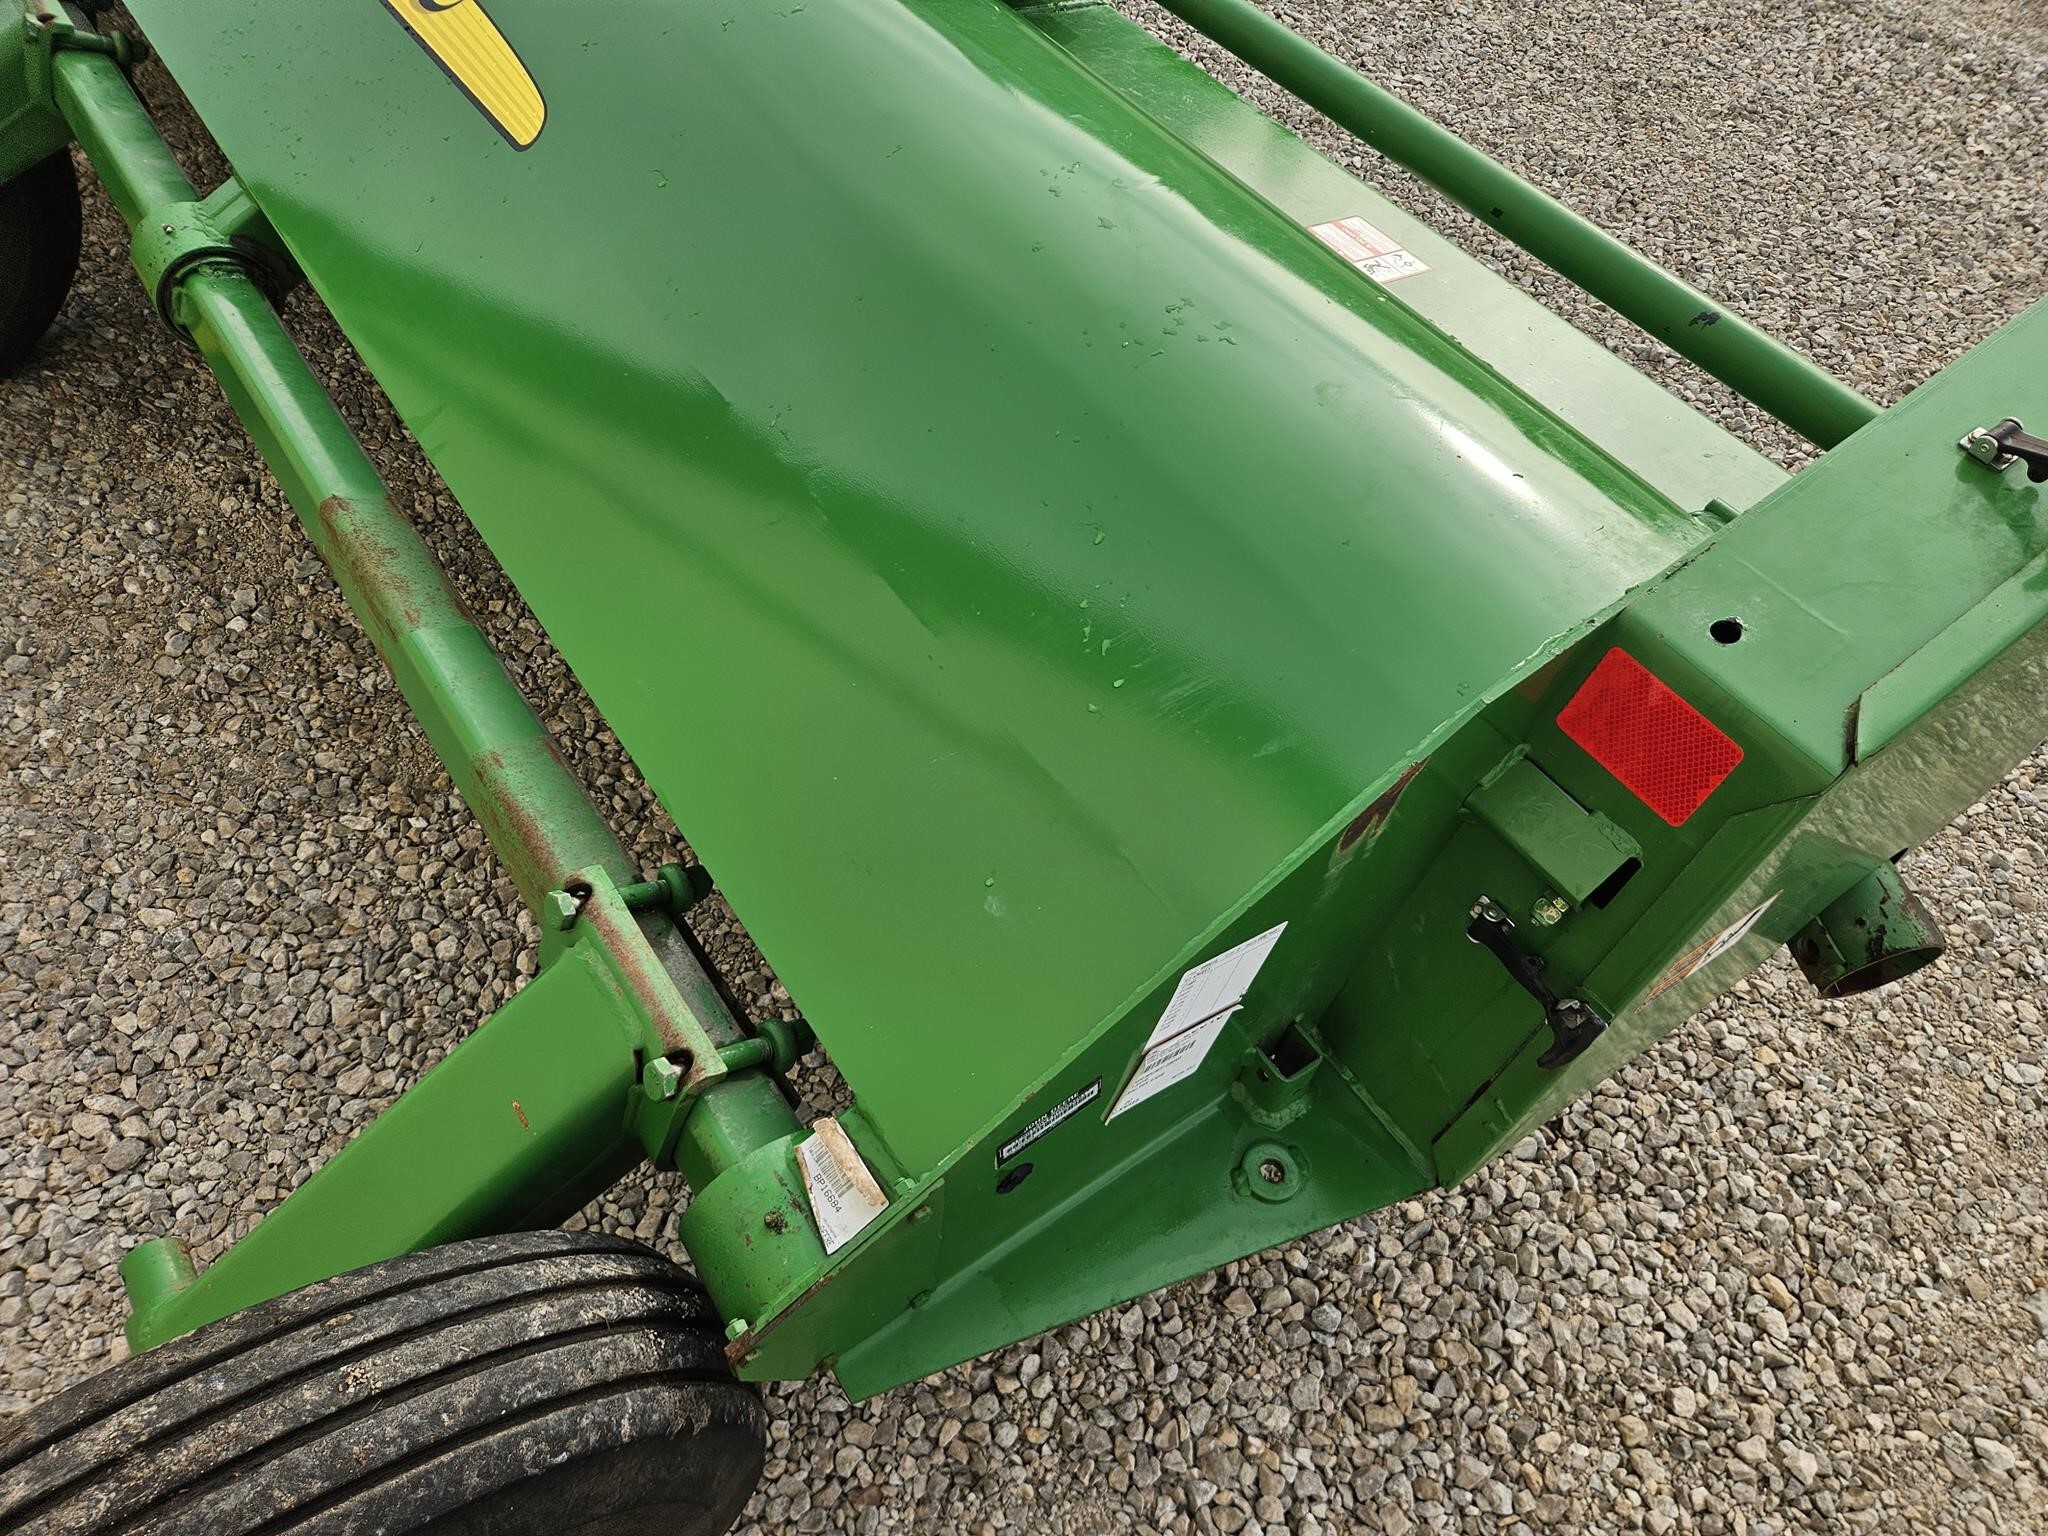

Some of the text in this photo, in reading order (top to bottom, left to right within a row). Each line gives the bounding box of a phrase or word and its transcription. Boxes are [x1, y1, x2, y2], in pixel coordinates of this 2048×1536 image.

[1024, 1113, 1048, 1133] JOHN
[1050, 1091, 1079, 1115] DEERE
[813, 1173, 842, 1213] BP16684
